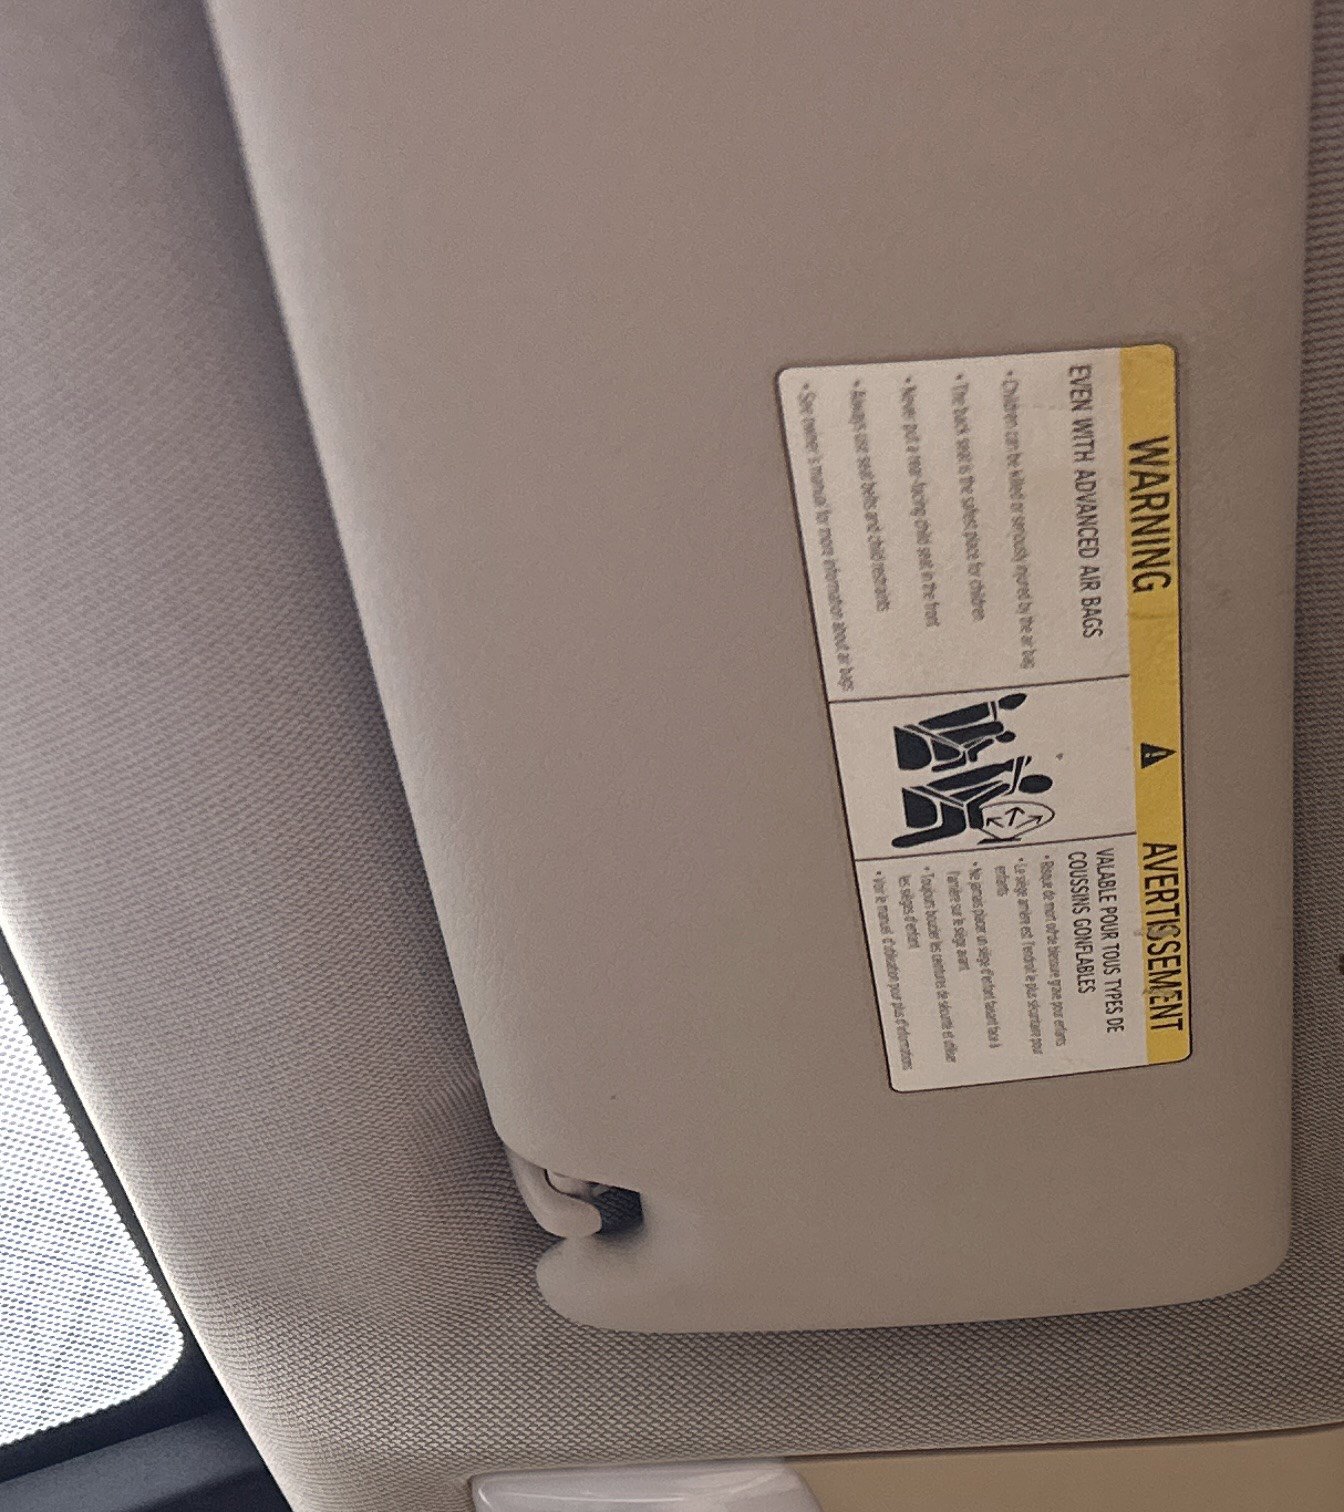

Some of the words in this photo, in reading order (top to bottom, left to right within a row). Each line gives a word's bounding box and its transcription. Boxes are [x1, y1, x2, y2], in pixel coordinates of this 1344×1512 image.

[1069, 364, 1093, 412] EVEN
[1071, 418, 1096, 463] WITH
[1075, 470, 1099, 558] ADVANCED
[1129, 436, 1171, 593] WARNING
[1080, 565, 1101, 591] AIR
[1082, 597, 1103, 638] BAGS
[1068, 852, 1090, 914] COUSSINS
[1096, 848, 1118, 903] VALABLE
[1100, 907, 1119, 940] POUR
[1143, 842, 1183, 1031] AVERTISSEMENT
[1072, 919, 1096, 994] GONFLABLES
[1102, 943, 1121, 976] TOUS
[1104, 978, 1124, 1014] TYPES
[1106, 1018, 1124, 1034] DE
